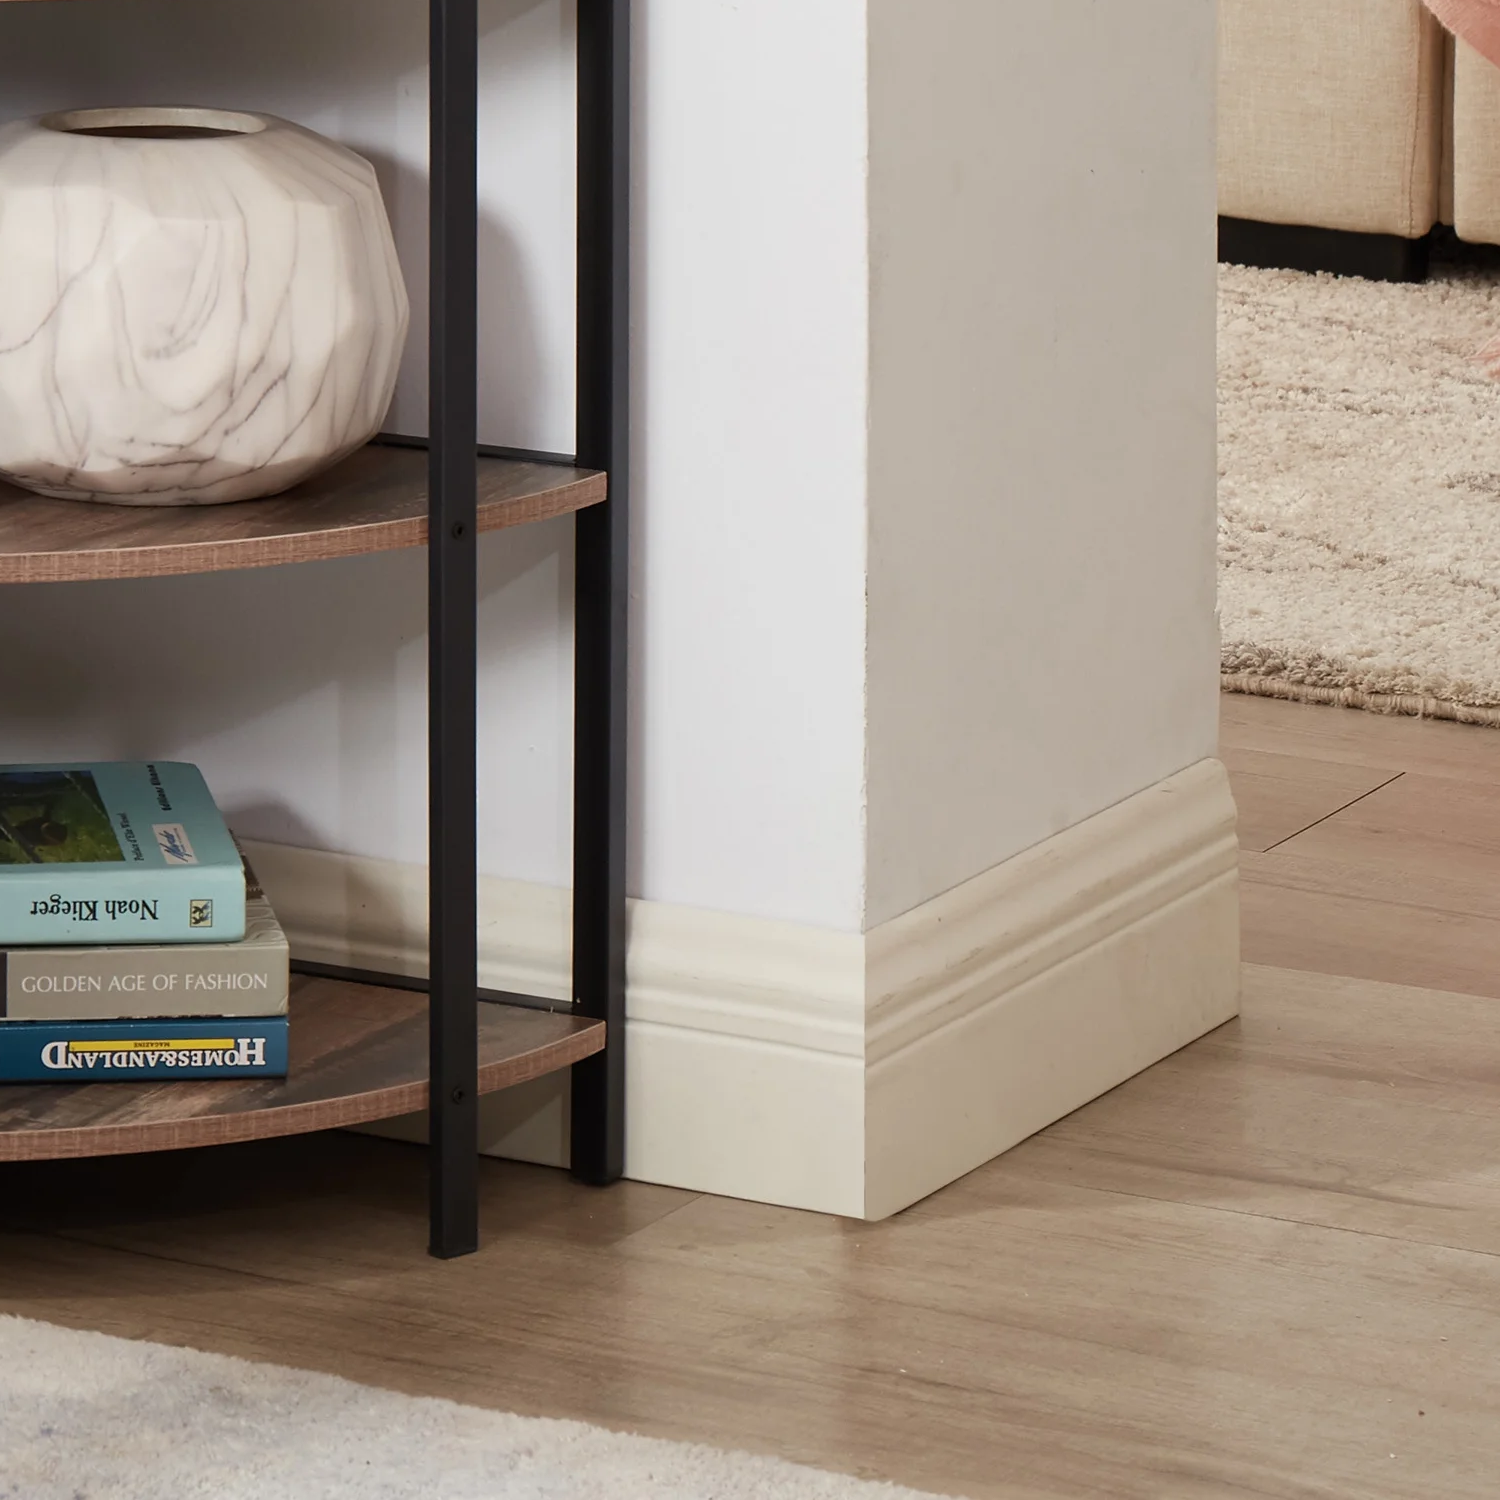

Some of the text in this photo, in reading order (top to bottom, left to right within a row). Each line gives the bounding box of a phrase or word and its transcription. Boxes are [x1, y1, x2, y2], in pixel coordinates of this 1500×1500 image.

[30, 894, 159, 921] Noah Klieger
[21, 973, 268, 993] GOLDEN AGE OF FASHION
